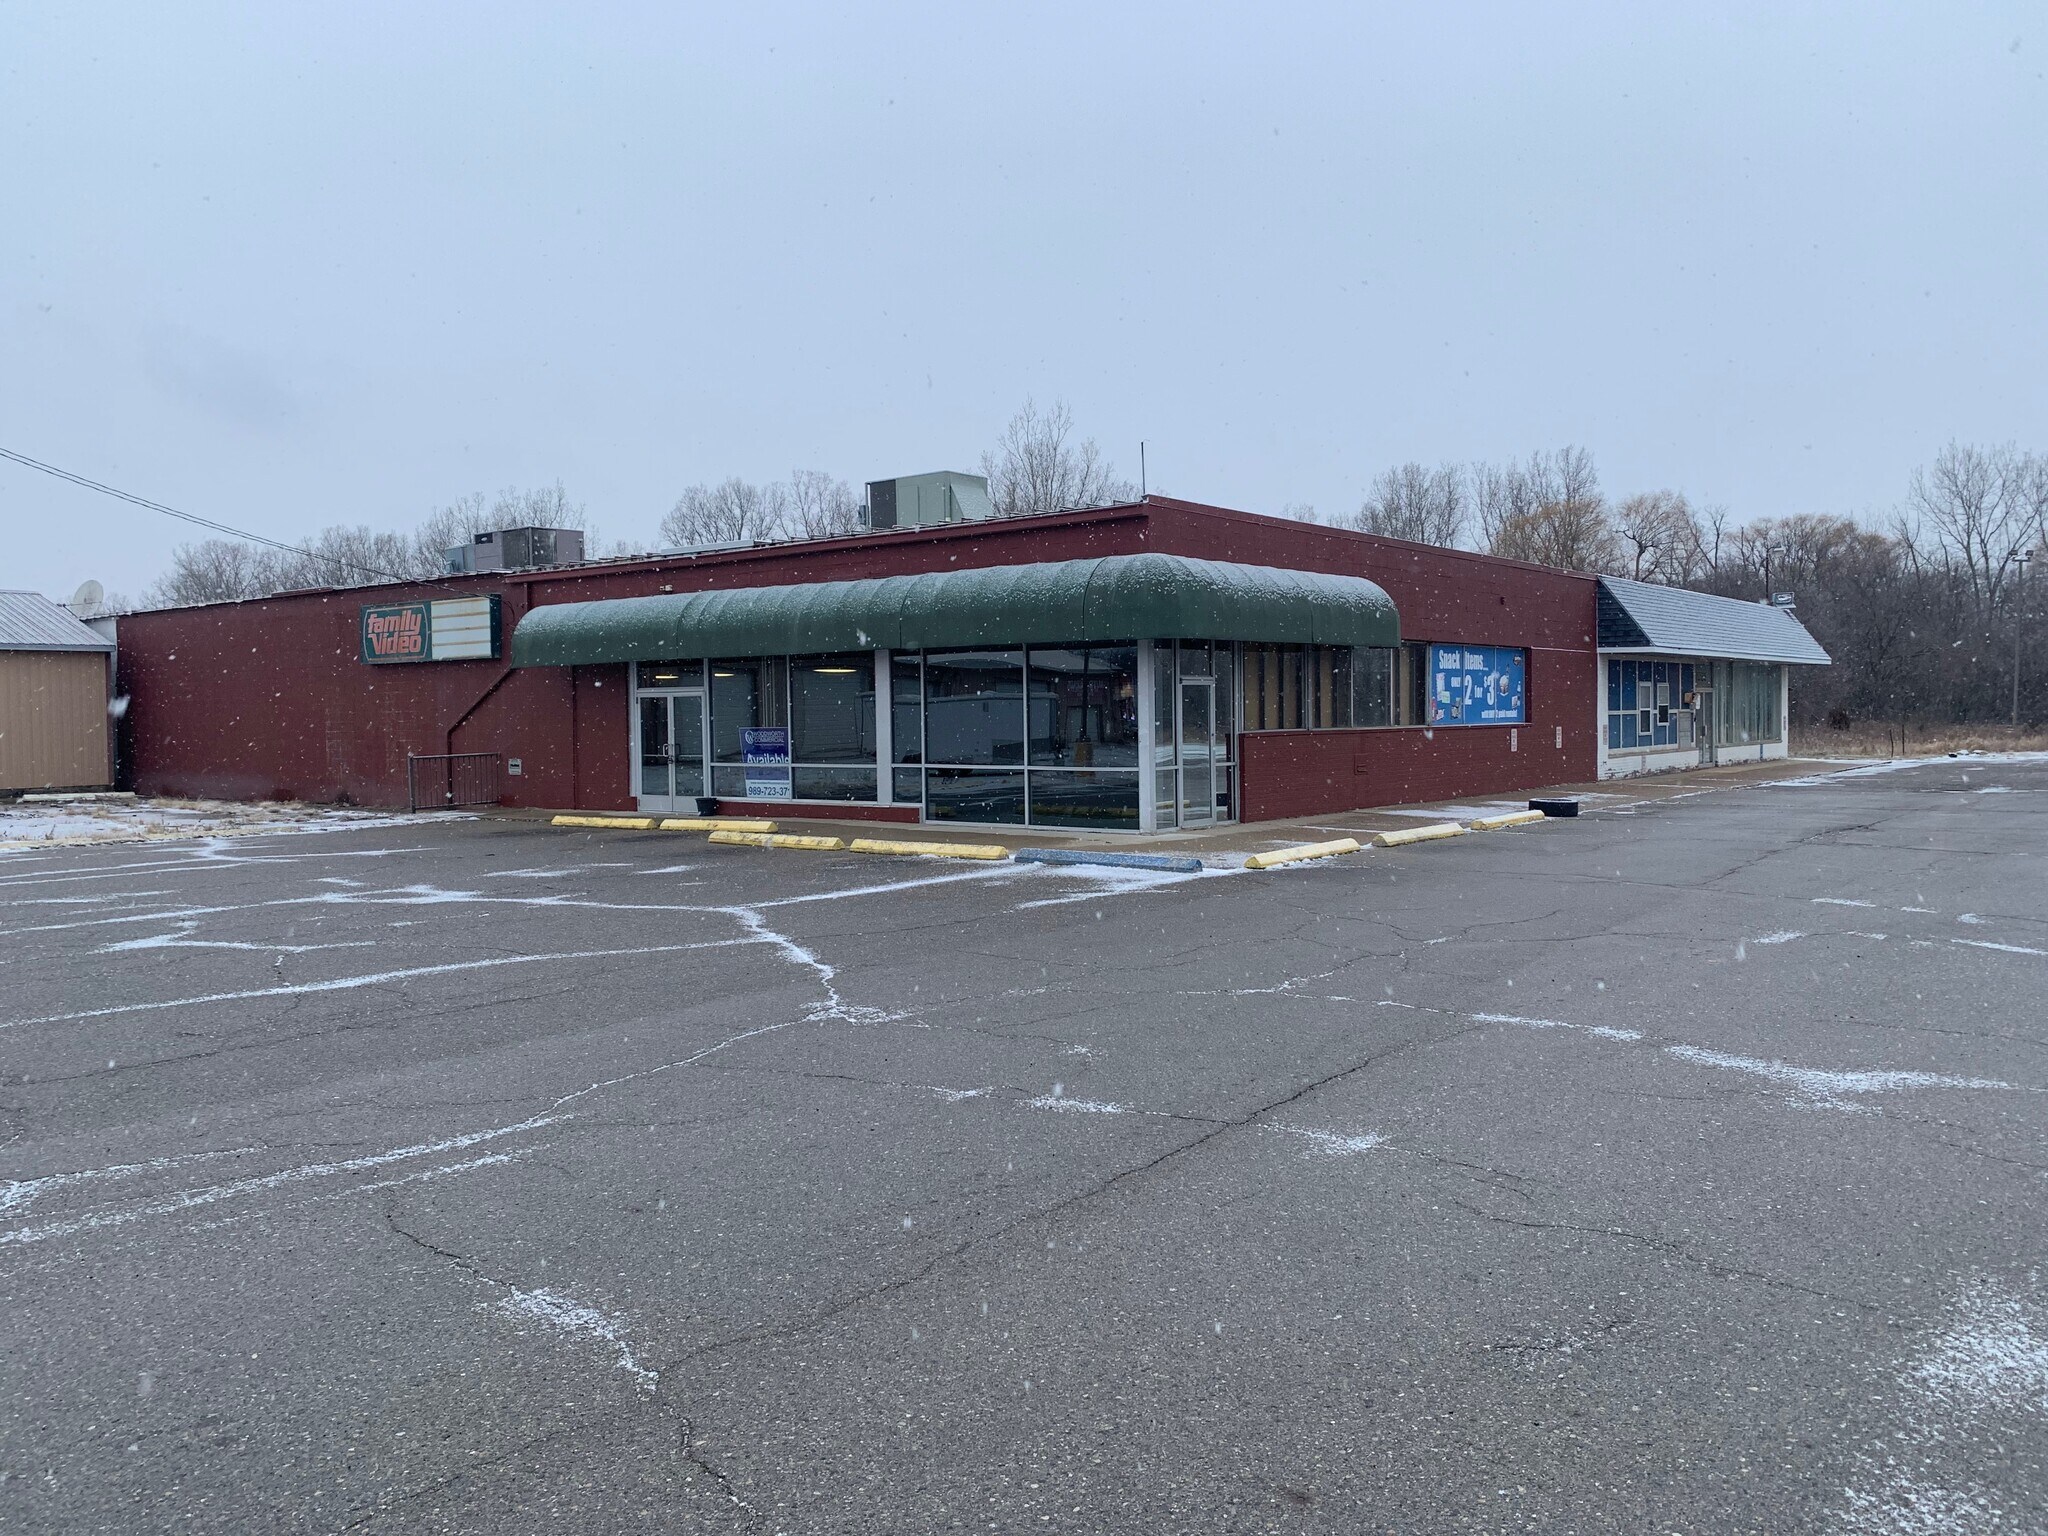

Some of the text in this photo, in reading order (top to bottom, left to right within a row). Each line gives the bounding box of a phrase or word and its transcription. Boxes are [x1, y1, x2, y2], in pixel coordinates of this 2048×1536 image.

[368, 609, 421, 635] family
[368, 632, 422, 655] Video
[1439, 650, 1460, 669] Snack
[1465, 675, 1472, 705] 2
[1474, 685, 1483, 698] for
[747, 753, 789, 763] Available
[748, 786, 790, 796] 989-723-37
